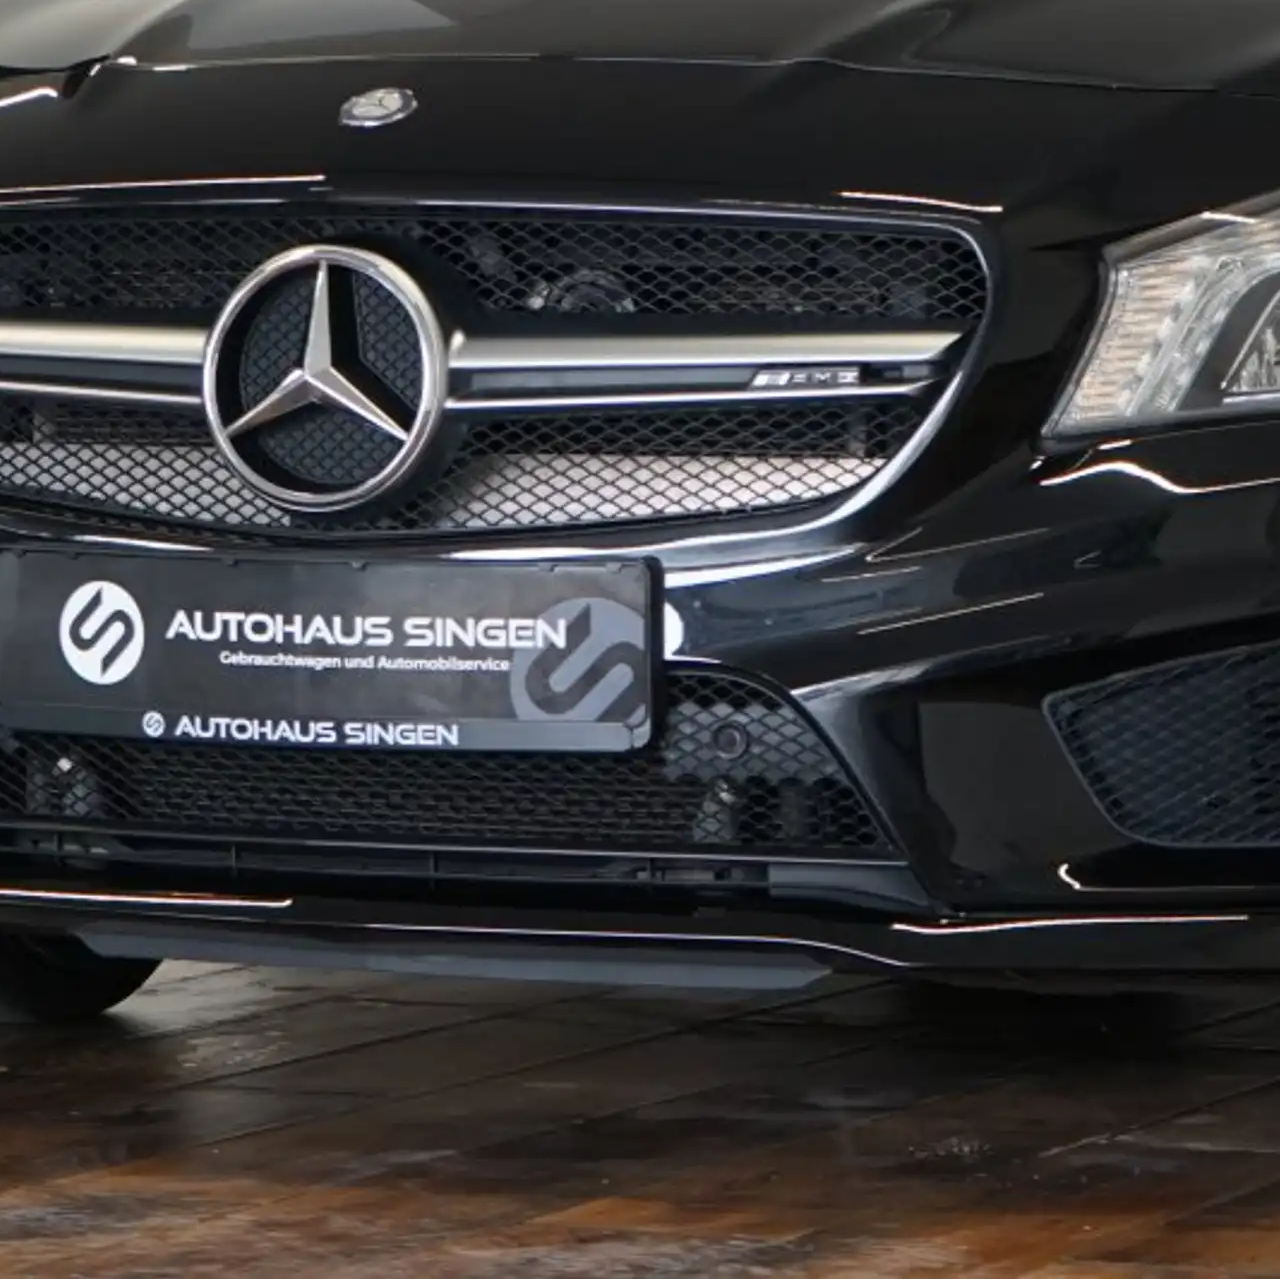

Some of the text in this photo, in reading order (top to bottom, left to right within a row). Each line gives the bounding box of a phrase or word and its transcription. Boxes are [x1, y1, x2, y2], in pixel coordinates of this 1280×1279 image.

[165, 609, 568, 650] AUTOHAUS SINGEN
[219, 650, 512, 672] Gebrauchtwagen und Automobilservice
[174, 715, 460, 746] AUTOHAUS SINGEN
